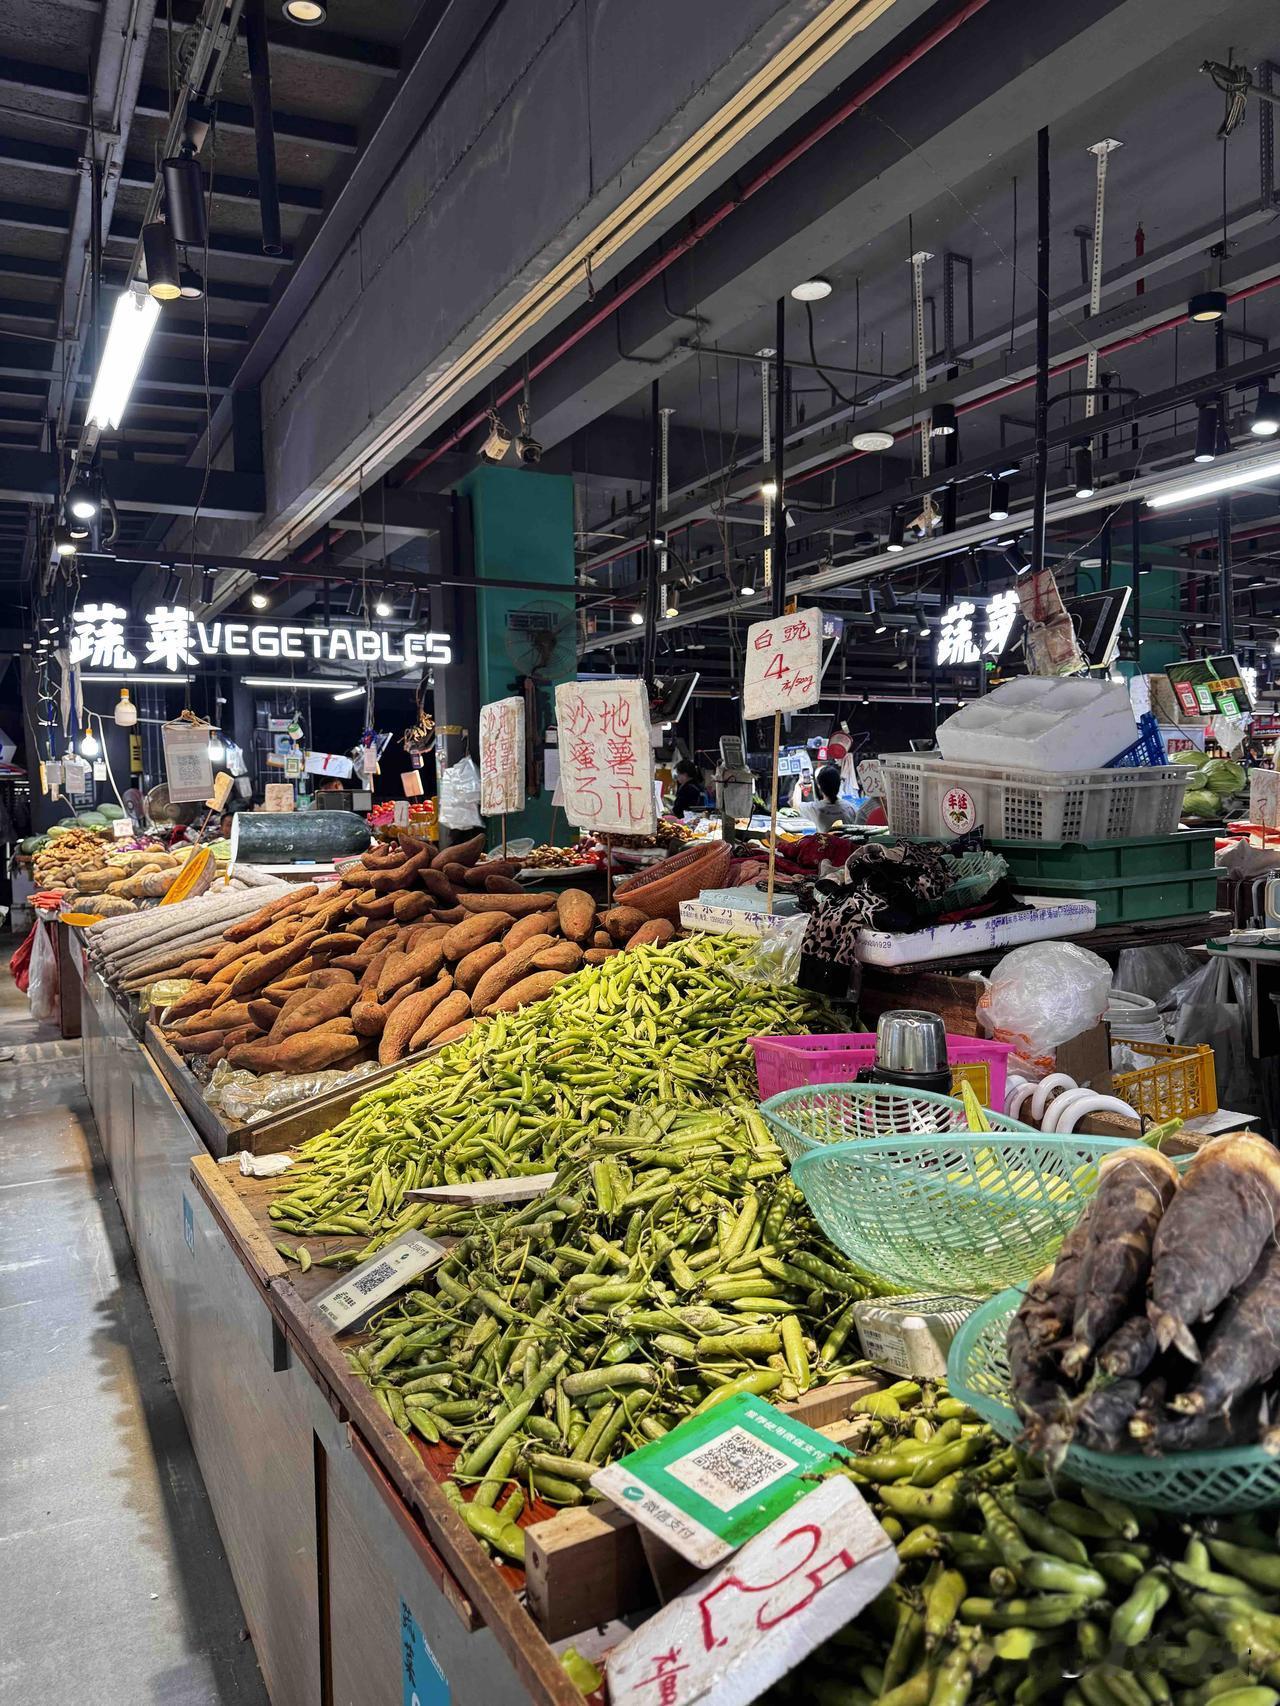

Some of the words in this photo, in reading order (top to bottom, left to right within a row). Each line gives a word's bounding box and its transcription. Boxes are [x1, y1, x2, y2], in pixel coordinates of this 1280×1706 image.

[70, 603, 200, 672] 蔬菜
[197, 622, 451, 665] VEGETABLES
[764, 653, 790, 680] 4
[565, 694, 632, 738] 沙地
[640, 1499, 697, 1541] 微信支付
